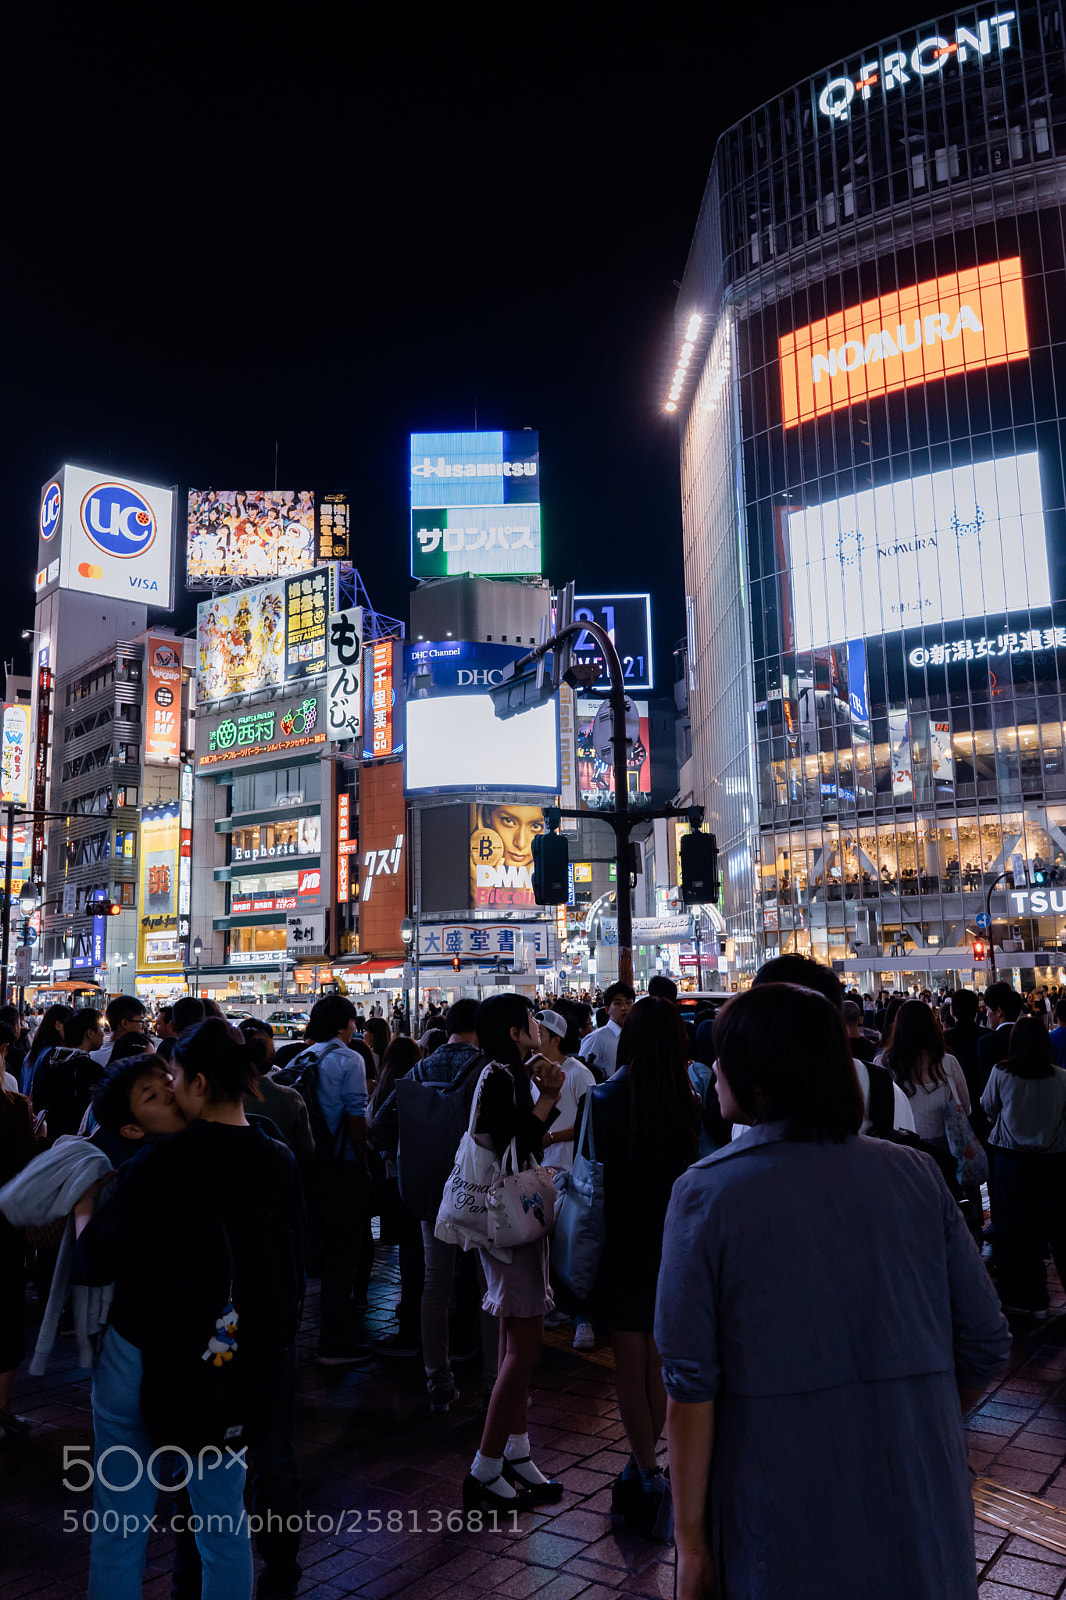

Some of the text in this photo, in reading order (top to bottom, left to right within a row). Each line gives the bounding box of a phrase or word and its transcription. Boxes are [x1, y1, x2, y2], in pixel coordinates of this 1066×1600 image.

[818, 10, 1015, 121] QFRONT
[811, 304, 984, 383] NOMURA
[411, 457, 537, 478] Hisamitsu
[90, 497, 148, 542] UC
[417, 526, 535, 553] サロンパス
[877, 537, 938, 559] NOMURA
[128, 575, 159, 592] VISA
[303, 628, 326, 641] ALBUM
[411, 647, 461, 660] DHC Channel
[330, 613, 360, 734] もんじゃ
[457, 669, 503, 686] DHC
[373, 647, 388, 750] 三千里薬品
[238, 719, 275, 746] 西村
[561, 738, 572, 786] neon
[475, 784, 489, 792] DHC
[234, 843, 295, 862] Euphoria
[363, 833, 404, 902] クスリ
[476, 864, 535, 888] DMM
[148, 865, 170, 895] 薬
[299, 873, 321, 892] JTB
[1011, 890, 1066, 914] TSU
